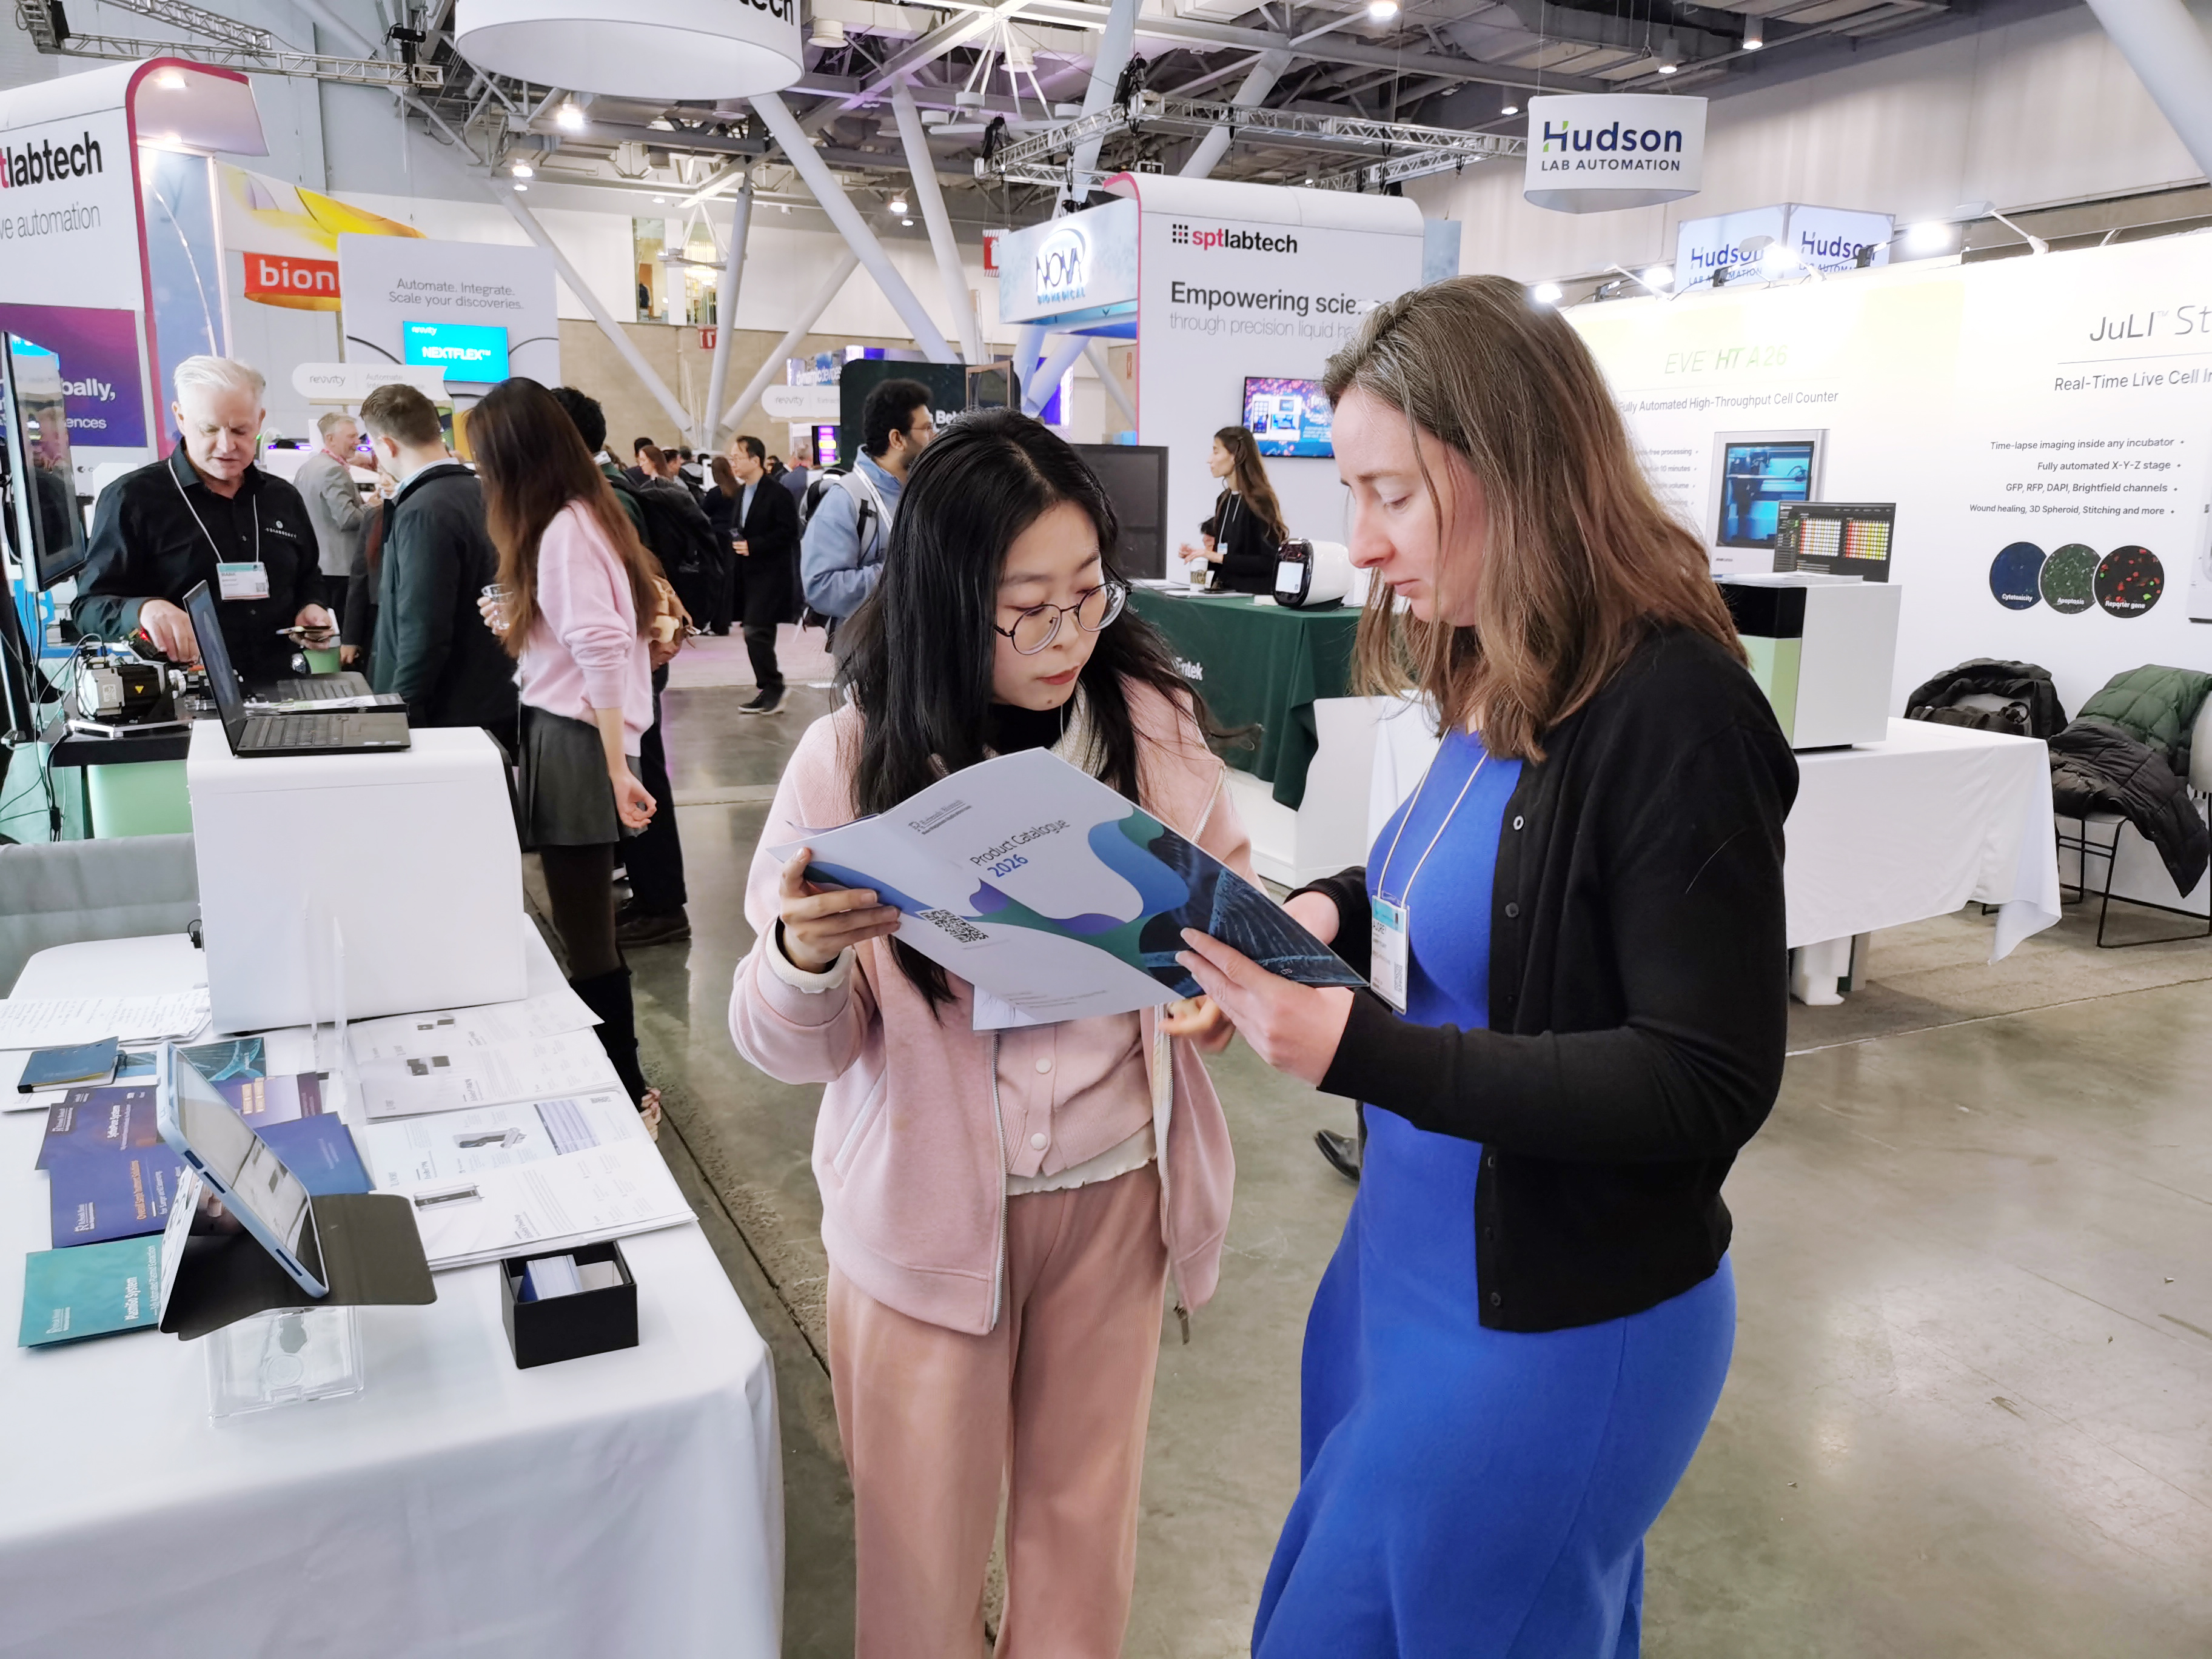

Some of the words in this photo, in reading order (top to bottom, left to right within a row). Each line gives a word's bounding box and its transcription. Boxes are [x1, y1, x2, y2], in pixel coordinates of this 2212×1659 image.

[1543, 120, 1682, 152] Hudson
[1541, 160, 1570, 171] LAB
[1575, 159, 1680, 171] AUTOMATION
[17, 201, 101, 238] automation
[1192, 229, 1298, 253] sptlabtech
[1801, 231, 1875, 261] Hudso
[260, 260, 335, 291] bion
[1036, 247, 1082, 293] NOVA
[397, 278, 457, 293] Automate.
[461, 283, 515, 297] Integrate.
[389, 292, 421, 304] Scale
[424, 295, 452, 308] your
[455, 295, 524, 310] discoveries.
[1171, 281, 1309, 317] Empowering
[1315, 293, 1362, 315] scie
[1170, 313, 1226, 336] through
[1230, 319, 1294, 338] precision
[1299, 318, 1334, 341] liquid
[309, 374, 346, 387] revvity
[2054, 374, 2128, 391] Real-Time
[2133, 370, 2163, 387] Live
[2168, 367, 2200, 385] Cell
[776, 395, 805, 407] revvity
[1639, 397, 1687, 412] Automated
[1689, 394, 1772, 412] High-Throughput
[1774, 392, 1794, 405] Cell
[1796, 390, 1839, 404] Counter
[1661, 447, 1692, 456] processing
[1990, 441, 2038, 451] Time-lapse
[2040, 440, 2076, 451] imaging
[2077, 439, 2105, 448] inside
[2107, 441, 2125, 449] any
[2127, 438, 2175, 447] incubator
[2037, 462, 2058, 472] Fully
[2060, 461, 2110, 470] automated
[2112, 461, 2141, 469] X-Y-Z
[2143, 461, 2171, 472] stage
[2006, 483, 2025, 494] GFP,
[2026, 483, 2045, 494] RFP,
[2046, 483, 2070, 494] DAPI,
[2072, 483, 2121, 494] Brightfield
[2123, 483, 2168, 492] channels
[1997, 504, 2027, 515] healing,
[2042, 505, 2080, 515] Spheroid,
[2082, 506, 2121, 516] Stitching
[2002, 594, 2033, 602] Cytotoxicity
[2057, 597, 2085, 606] Apoptosis
[970, 840, 1017, 866] Product
[1011, 820, 1071, 843] Catalogue
[987, 854, 1028, 877] 2026
[125, 1276, 141, 1298] System
